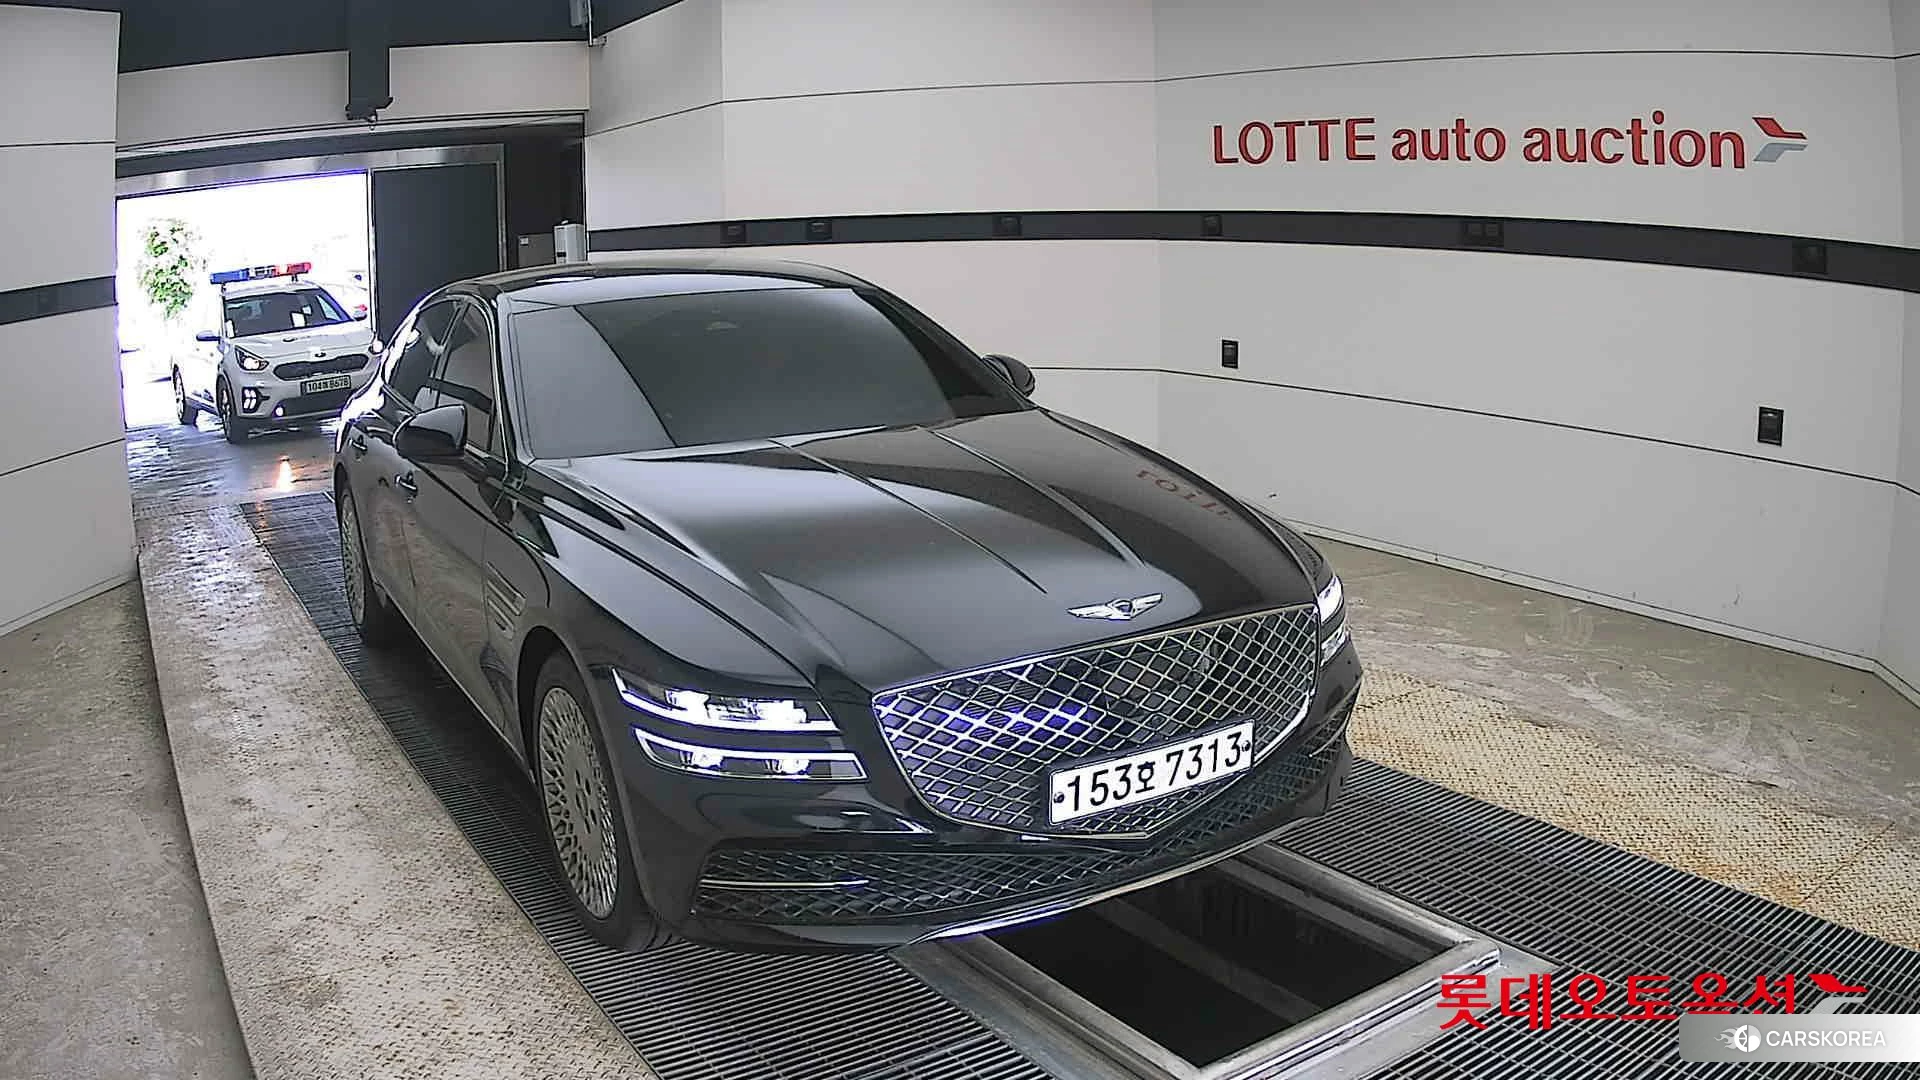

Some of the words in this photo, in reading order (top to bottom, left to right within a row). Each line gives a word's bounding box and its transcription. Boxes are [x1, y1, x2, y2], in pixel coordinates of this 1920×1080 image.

[1213, 117, 1376, 164] LOTTE
[1391, 118, 1506, 162] auto
[1522, 110, 1745, 169] auction
[1067, 761, 1156, 812] 153호
[1165, 731, 1243, 787] 7313
